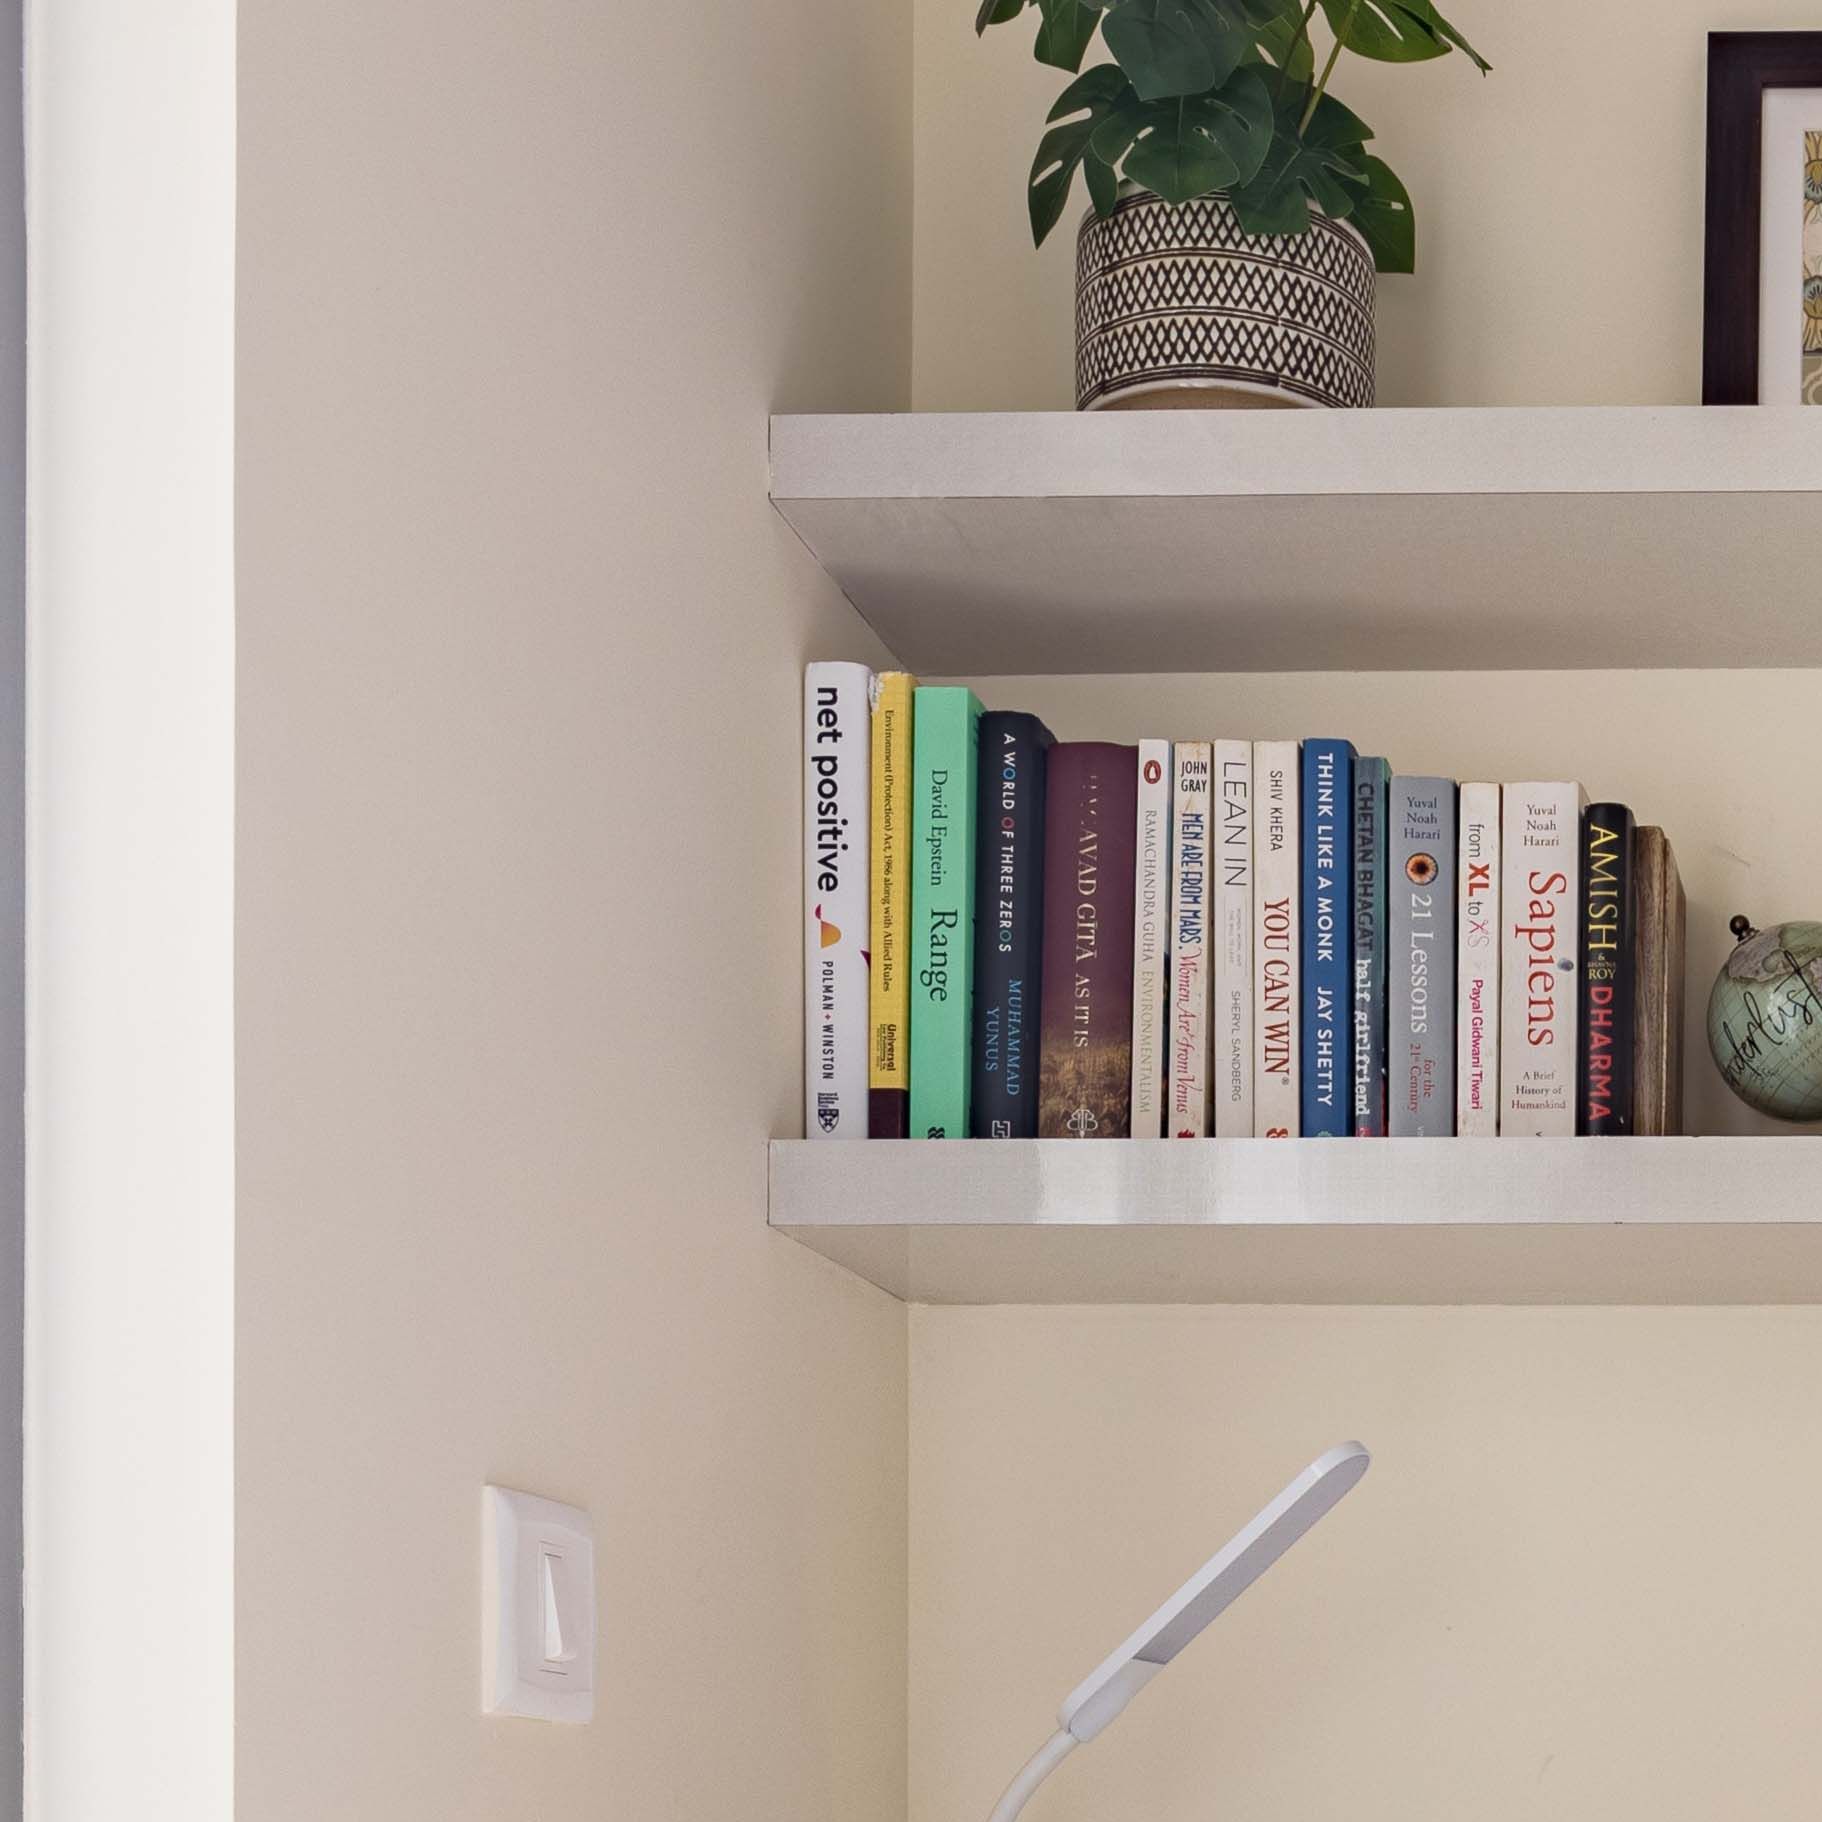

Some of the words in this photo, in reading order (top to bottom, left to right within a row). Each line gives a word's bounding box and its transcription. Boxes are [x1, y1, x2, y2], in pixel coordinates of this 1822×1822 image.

[816, 686, 843, 745] net
[883, 709, 895, 773] Environment
[1002, 733, 1015, 745] A
[1001, 752, 1015, 810] WORLD
[1181, 760, 1207, 776] JOHN
[1181, 779, 1207, 793] GRAY
[1270, 770, 1284, 801] SHIV
[1317, 752, 1334, 817] THINK
[882, 774, 894, 832] (Protection)
[930, 769, 948, 819] David
[1223, 761, 1247, 845] LEAN
[1407, 797, 1438, 809] Yuval
[1526, 804, 1557, 817] Yuval
[811, 754, 849, 893] positive
[1001, 816, 1014, 839] OF
[1181, 813, 1204, 840] MEN
[1269, 807, 1284, 851] KHERA
[1357, 783, 1375, 864] CHETAN
[1404, 827, 1441, 840] Harari
[1406, 812, 1438, 824] Noah
[1525, 819, 1557, 832] Noah
[926, 826, 948, 887] Epstein
[1181, 844, 1203, 868] ARE
[1317, 825, 1334, 869] LIKE
[1467, 823, 1485, 858] from
[1523, 835, 1560, 847] Harari
[1000, 845, 1014, 893] THREE
[1142, 809, 1157, 918] RAMACHANDRA
[1223, 858, 1247, 886] IN
[1317, 876, 1334, 890] A
[1468, 863, 1490, 897] XL
[881, 877, 893, 905] along
[1180, 871, 1203, 905] FROM
[1588, 823, 1619, 950] AMISH
[883, 906, 894, 929] with
[1263, 896, 1290, 952] YOU
[1357, 869, 1374, 952] BHAGAT
[1411, 893, 1433, 920] 21
[1468, 901, 1484, 916] to
[999, 900, 1013, 953] ZEROS
[1142, 921, 1155, 962] GUHA
[1317, 896, 1334, 962] MONK
[1467, 919, 1490, 948] XS
[883, 931, 894, 962] Allied
[919, 908, 958, 1002] Range
[1515, 871, 1567, 1047] Sapiens
[821, 960, 833, 1010] POLMAN
[883, 963, 894, 992] Rules
[1075, 974, 1092, 999] AS
[1177, 948, 1202, 1003] Women
[1263, 959, 1290, 1014] CAN
[1356, 959, 1371, 1003] half
[1410, 931, 1434, 1033] Lessons
[1588, 968, 1616, 980] ROY
[1231, 990, 1241, 1034] SHERYL
[1317, 986, 1334, 1022] JAY
[1468, 979, 1484, 1013] Payal
[1075, 1007, 1093, 1025] IT
[1177, 1004, 1197, 1038] Are
[821, 1023, 833, 1080] WINSTON
[886, 1023, 897, 1071] Universal
[985, 1006, 1000, 1072] YUNUS
[1006, 979, 1023, 1096] MUHAMMAD
[1075, 1029, 1092, 1048] IS
[1139, 971, 1154, 1113] ENVIRONMENTALISM
[1175, 1038, 1195, 1074] from
[1471, 1016, 1484, 1069] Gidwani
[1588, 985, 1614, 1121] DHARMA
[1231, 1038, 1242, 1102] SANDBERG
[1317, 1028, 1334, 1107] SHETTY
[1354, 1010, 1371, 1117] girlfriend
[1423, 1059, 1436, 1077] for
[1523, 1071, 1531, 1081] A
[1533, 1071, 1555, 1081] Brief
[1175, 1075, 1202, 1114] Venus
[1407, 1065, 1422, 1114] Century
[1423, 1079, 1436, 1098] the
[1471, 1071, 1483, 1110] Tiwari
[1511, 1099, 1566, 1109] Humankind
[1515, 1085, 1549, 1096] History
[1552, 1085, 1562, 1095] of
